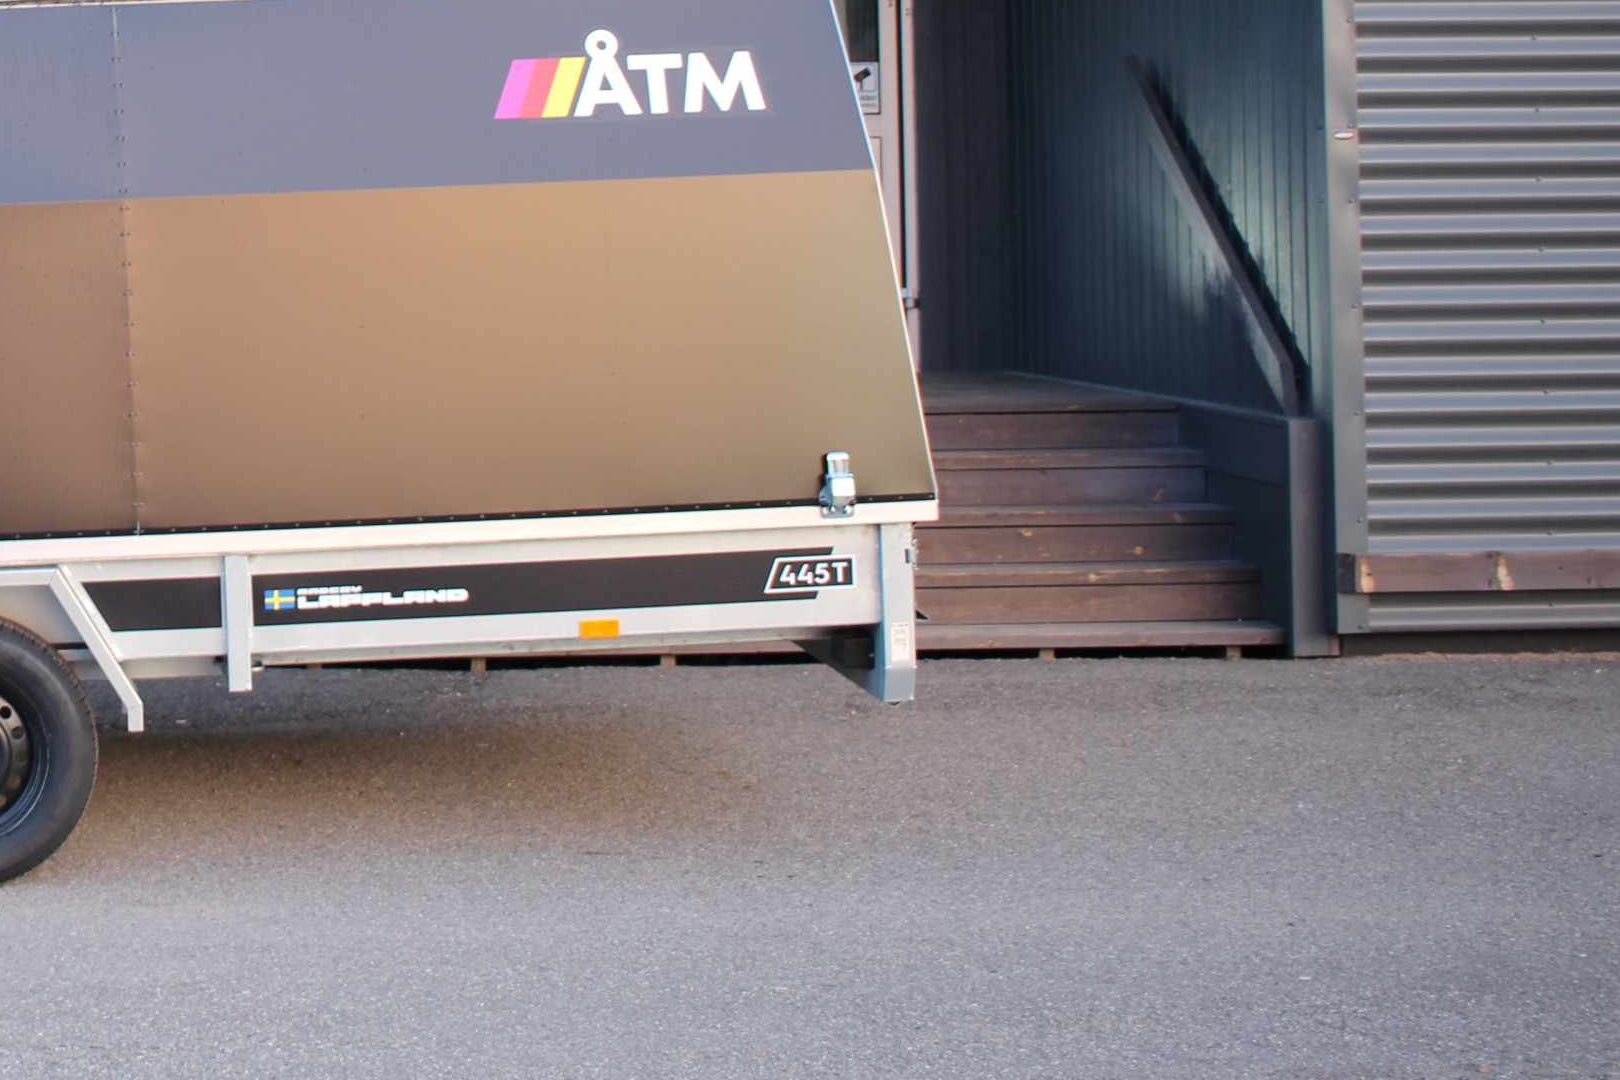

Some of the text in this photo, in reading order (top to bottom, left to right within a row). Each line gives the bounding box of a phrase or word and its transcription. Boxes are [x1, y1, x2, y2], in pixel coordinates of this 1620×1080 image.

[573, 28, 767, 118] ÅTM
[779, 561, 850, 586] 445T
[297, 587, 470, 610] LAPPLAND
